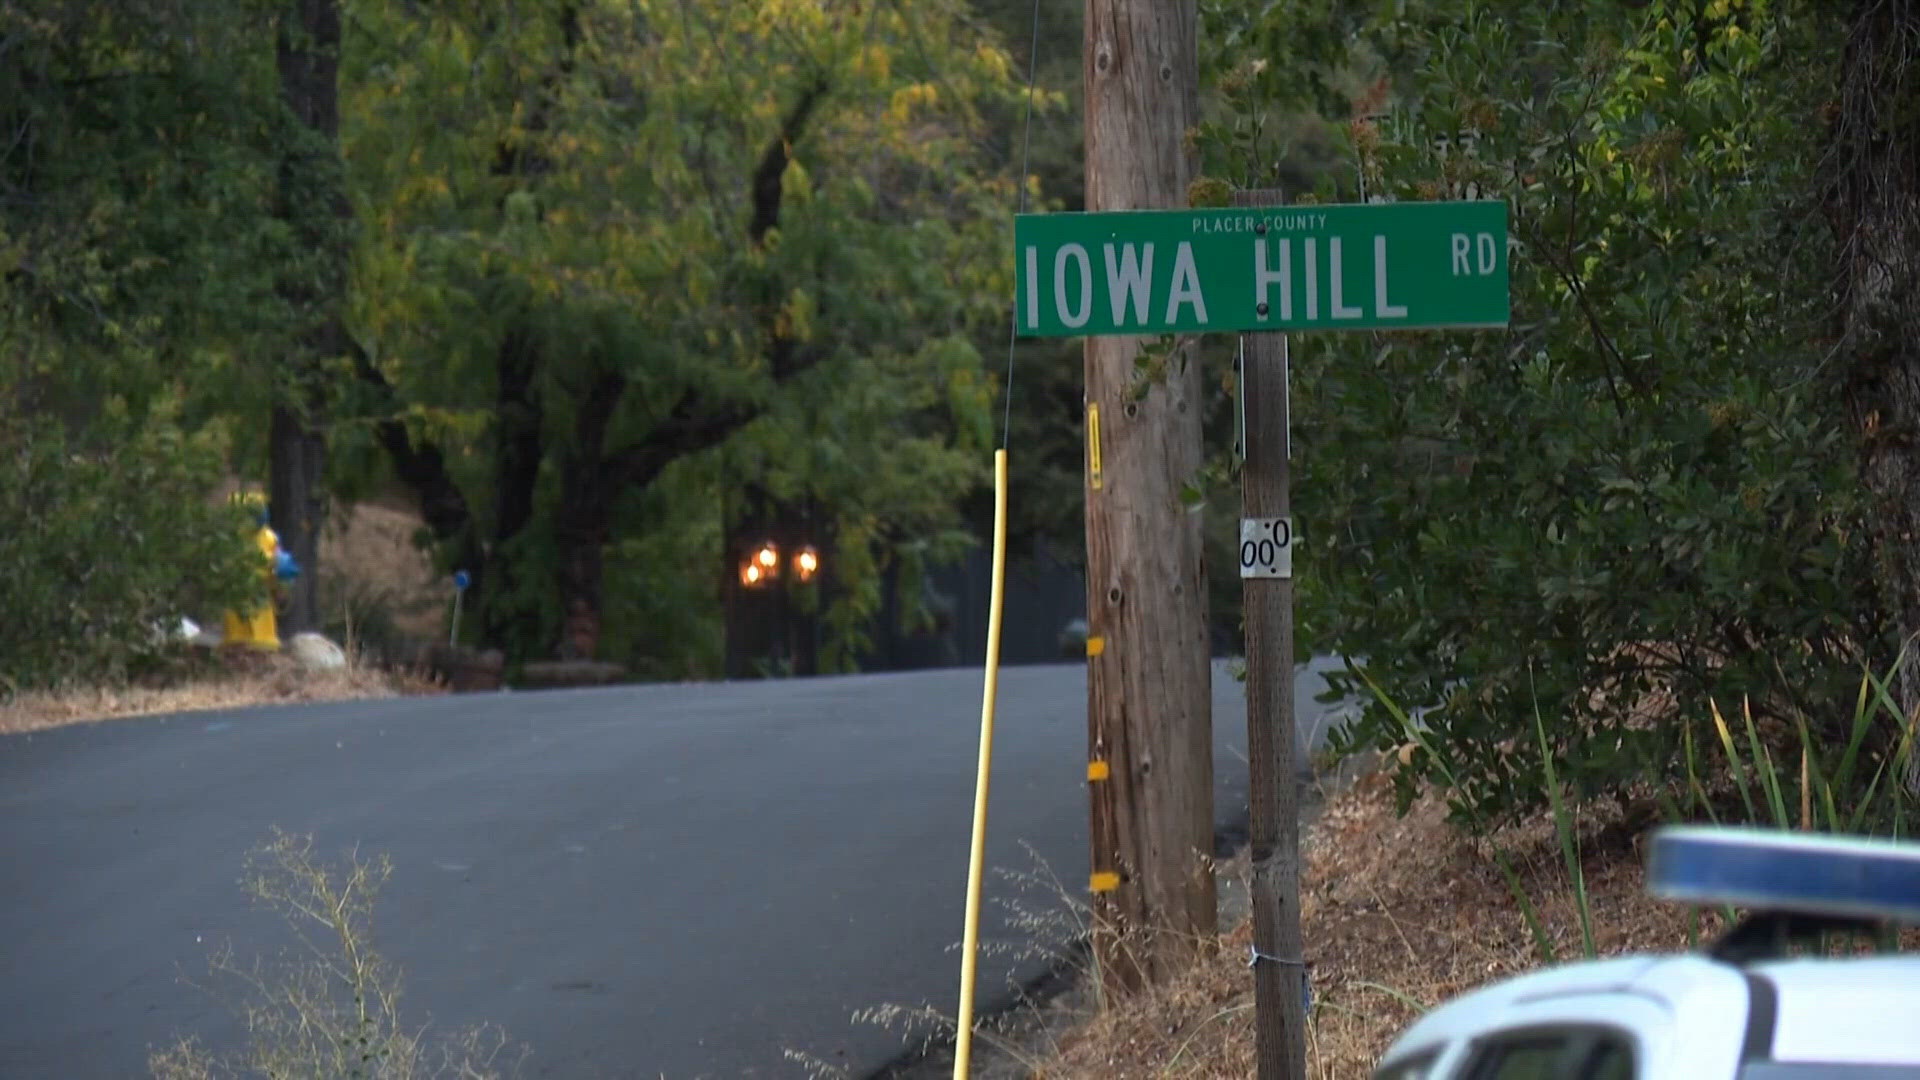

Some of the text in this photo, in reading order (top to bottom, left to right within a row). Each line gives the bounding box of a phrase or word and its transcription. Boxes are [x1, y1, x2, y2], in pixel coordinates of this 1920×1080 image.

[1193, 214, 1327, 233] PLACER COUNTY
[1025, 232, 1497, 329] IOWA HILL RD
